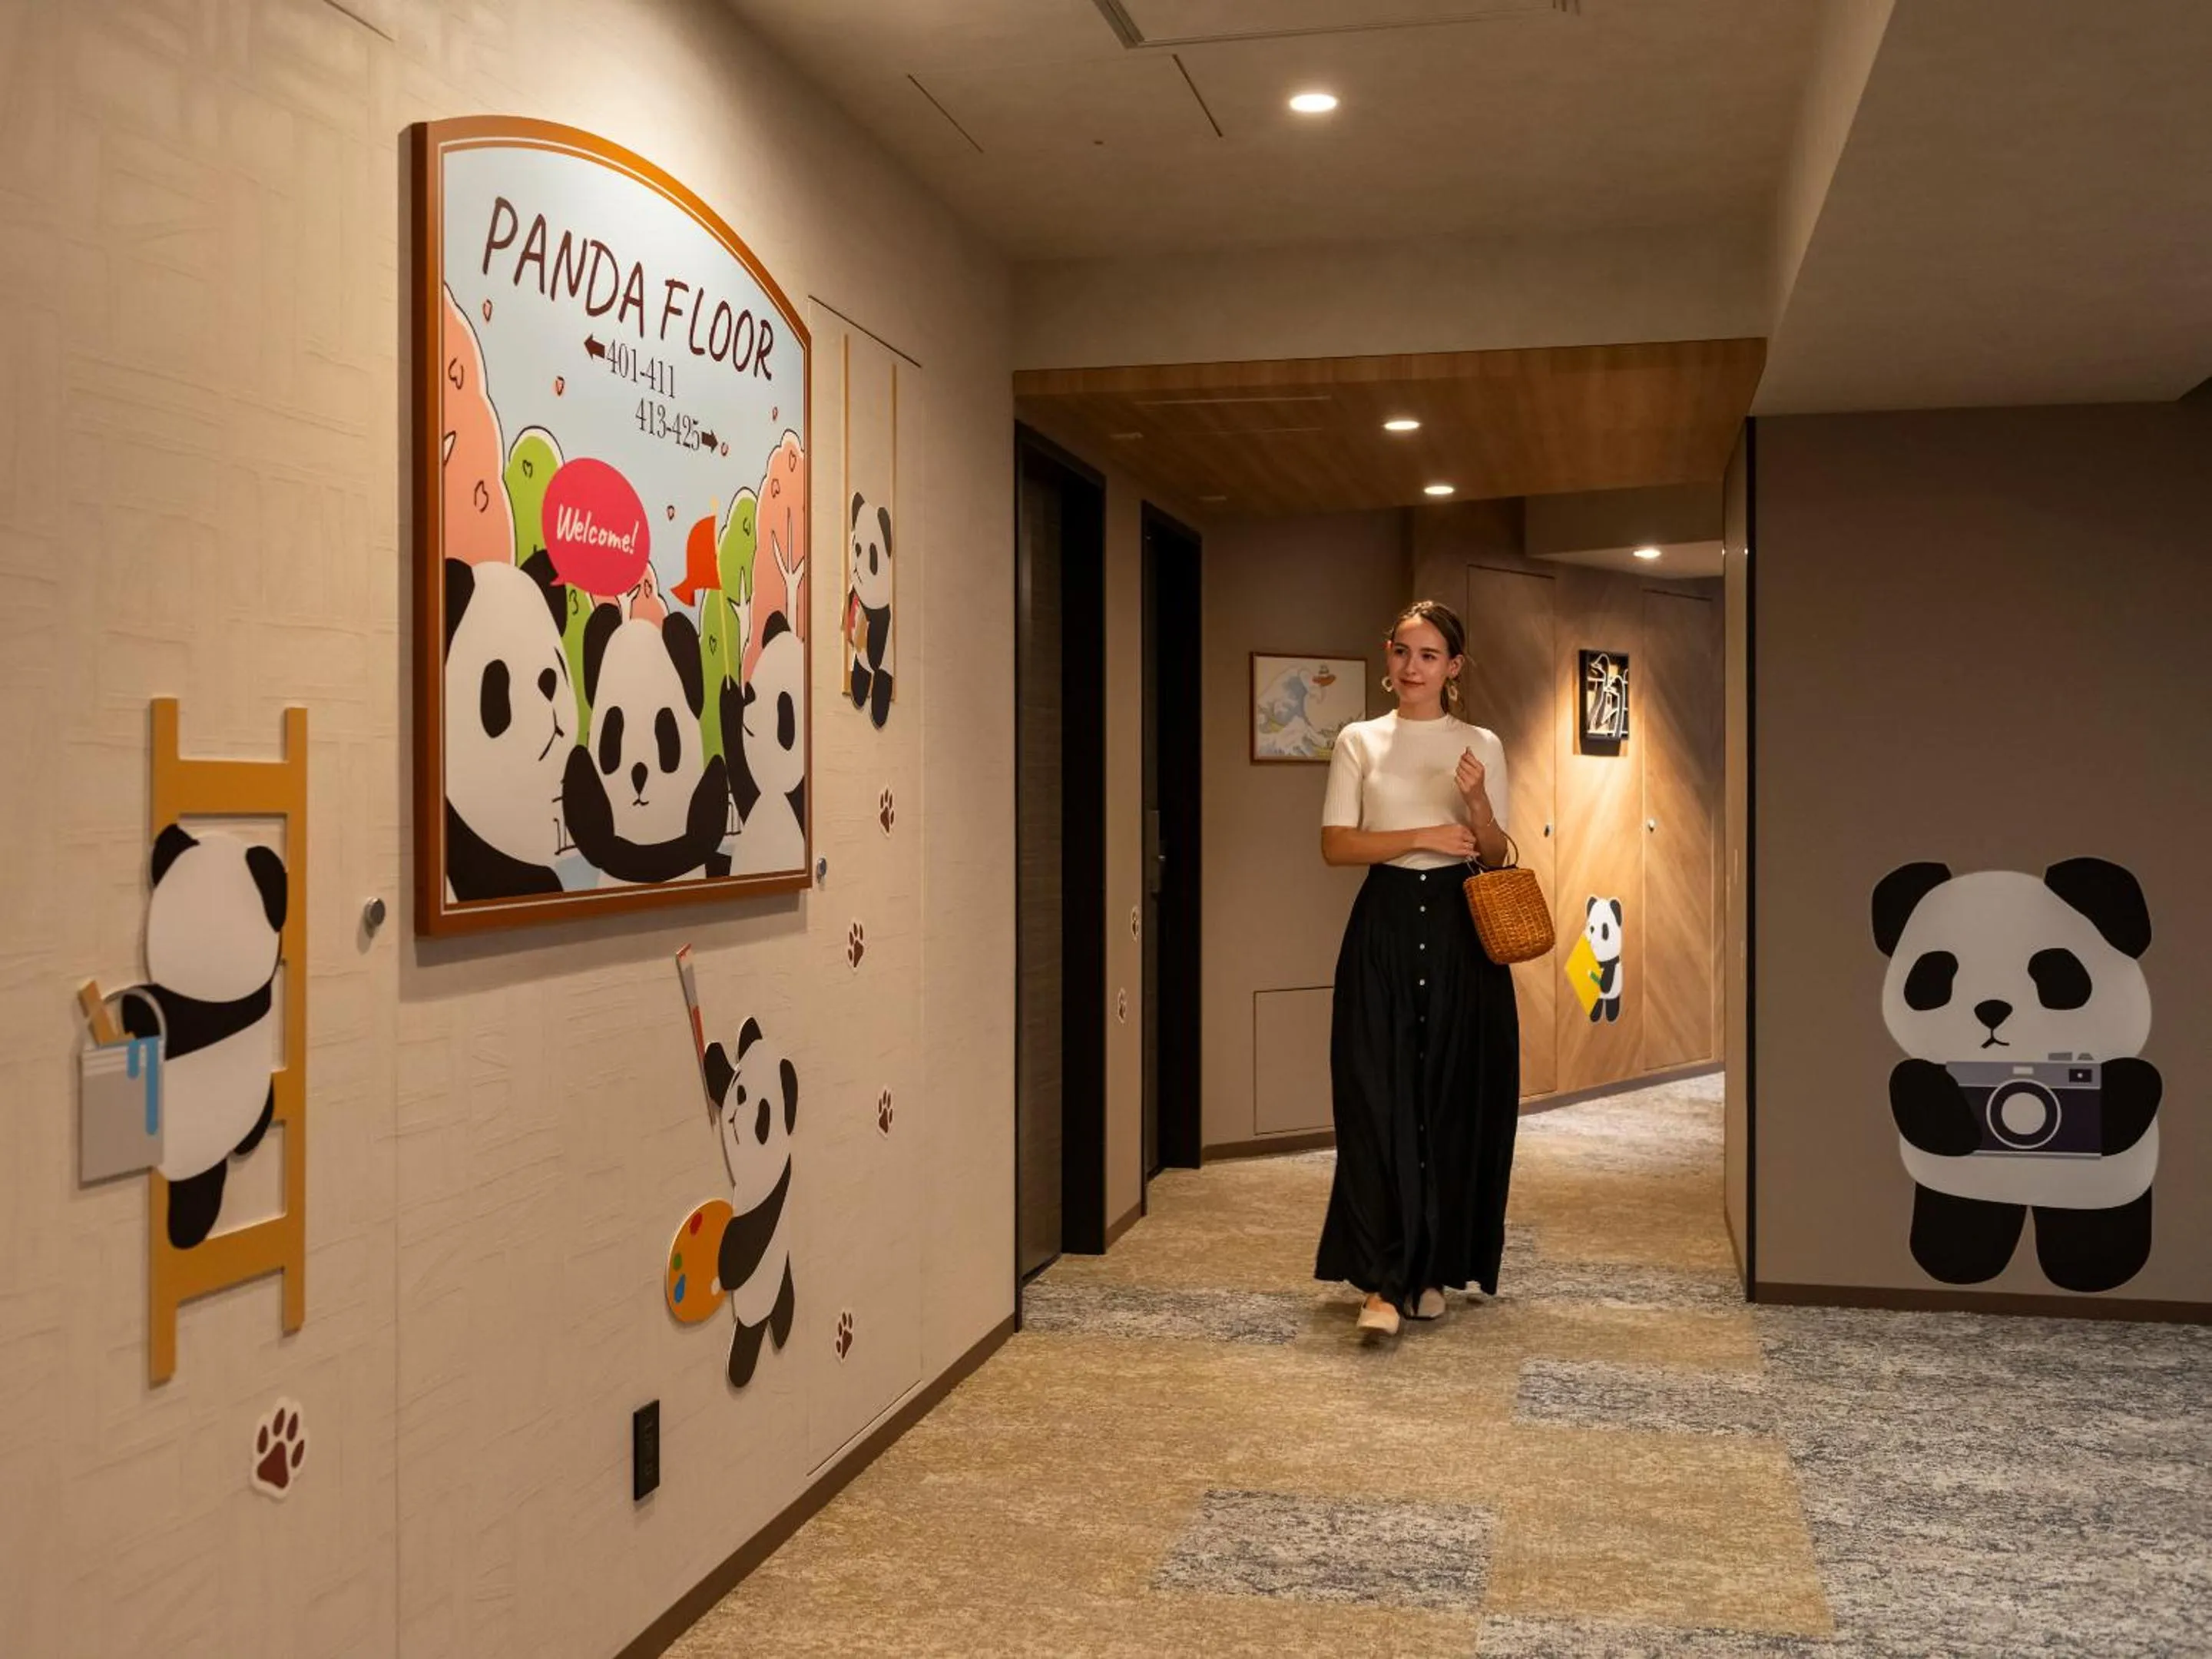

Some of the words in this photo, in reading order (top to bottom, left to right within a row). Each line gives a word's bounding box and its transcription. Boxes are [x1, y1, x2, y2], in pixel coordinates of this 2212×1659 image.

[483, 197, 644, 338] PANDA
[660, 279, 773, 381] FLOOR
[607, 339, 675, 398] 401-411
[635, 399, 700, 451] 413-425
[557, 505, 639, 554] Welcome!
